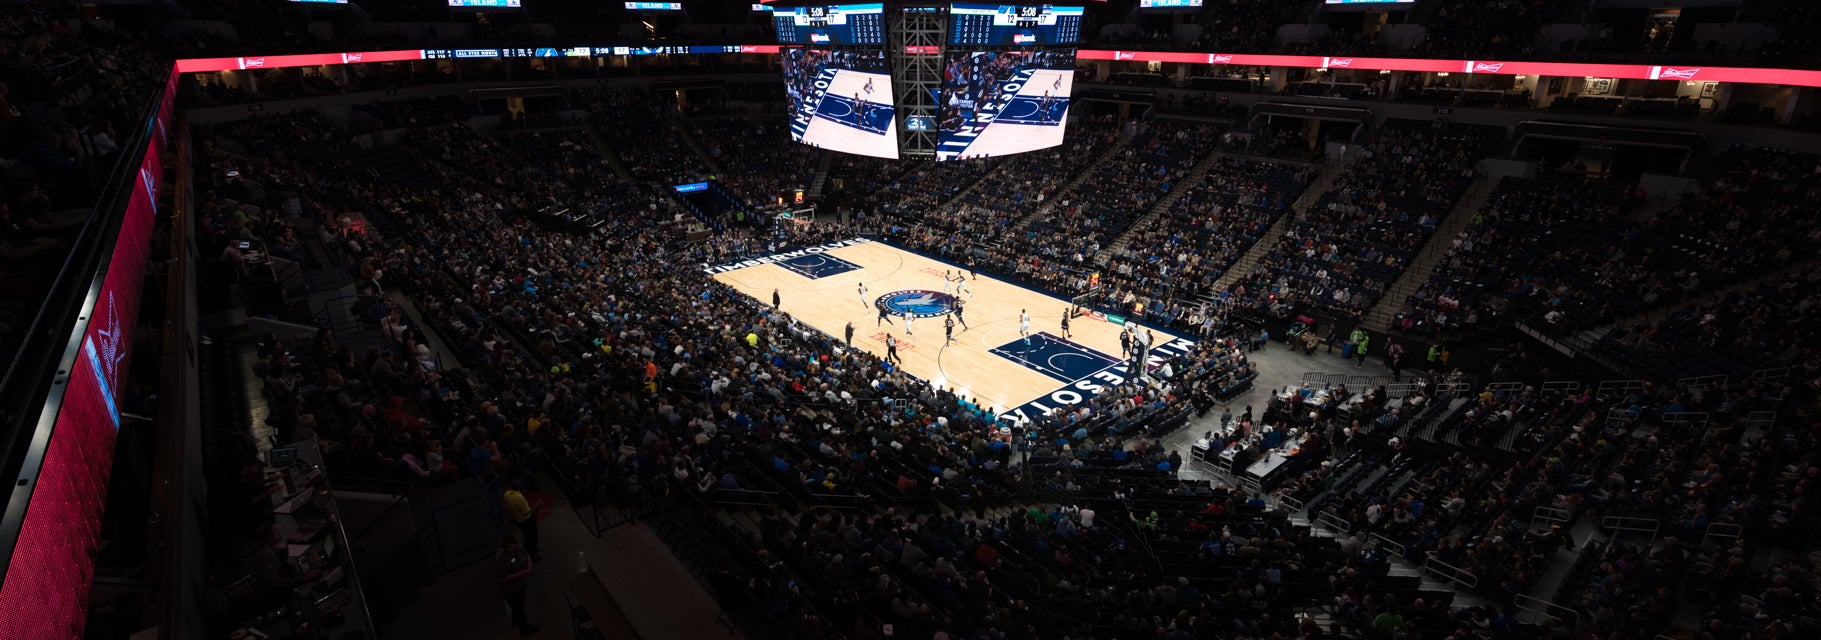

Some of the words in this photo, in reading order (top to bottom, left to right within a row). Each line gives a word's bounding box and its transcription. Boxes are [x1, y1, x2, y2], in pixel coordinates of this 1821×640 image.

[811, 7, 824, 17] 5:08
[1021, 7, 1036, 17] 5:08
[1040, 15, 1047, 24] 17
[702, 237, 872, 275] TIMBERWOLVES
